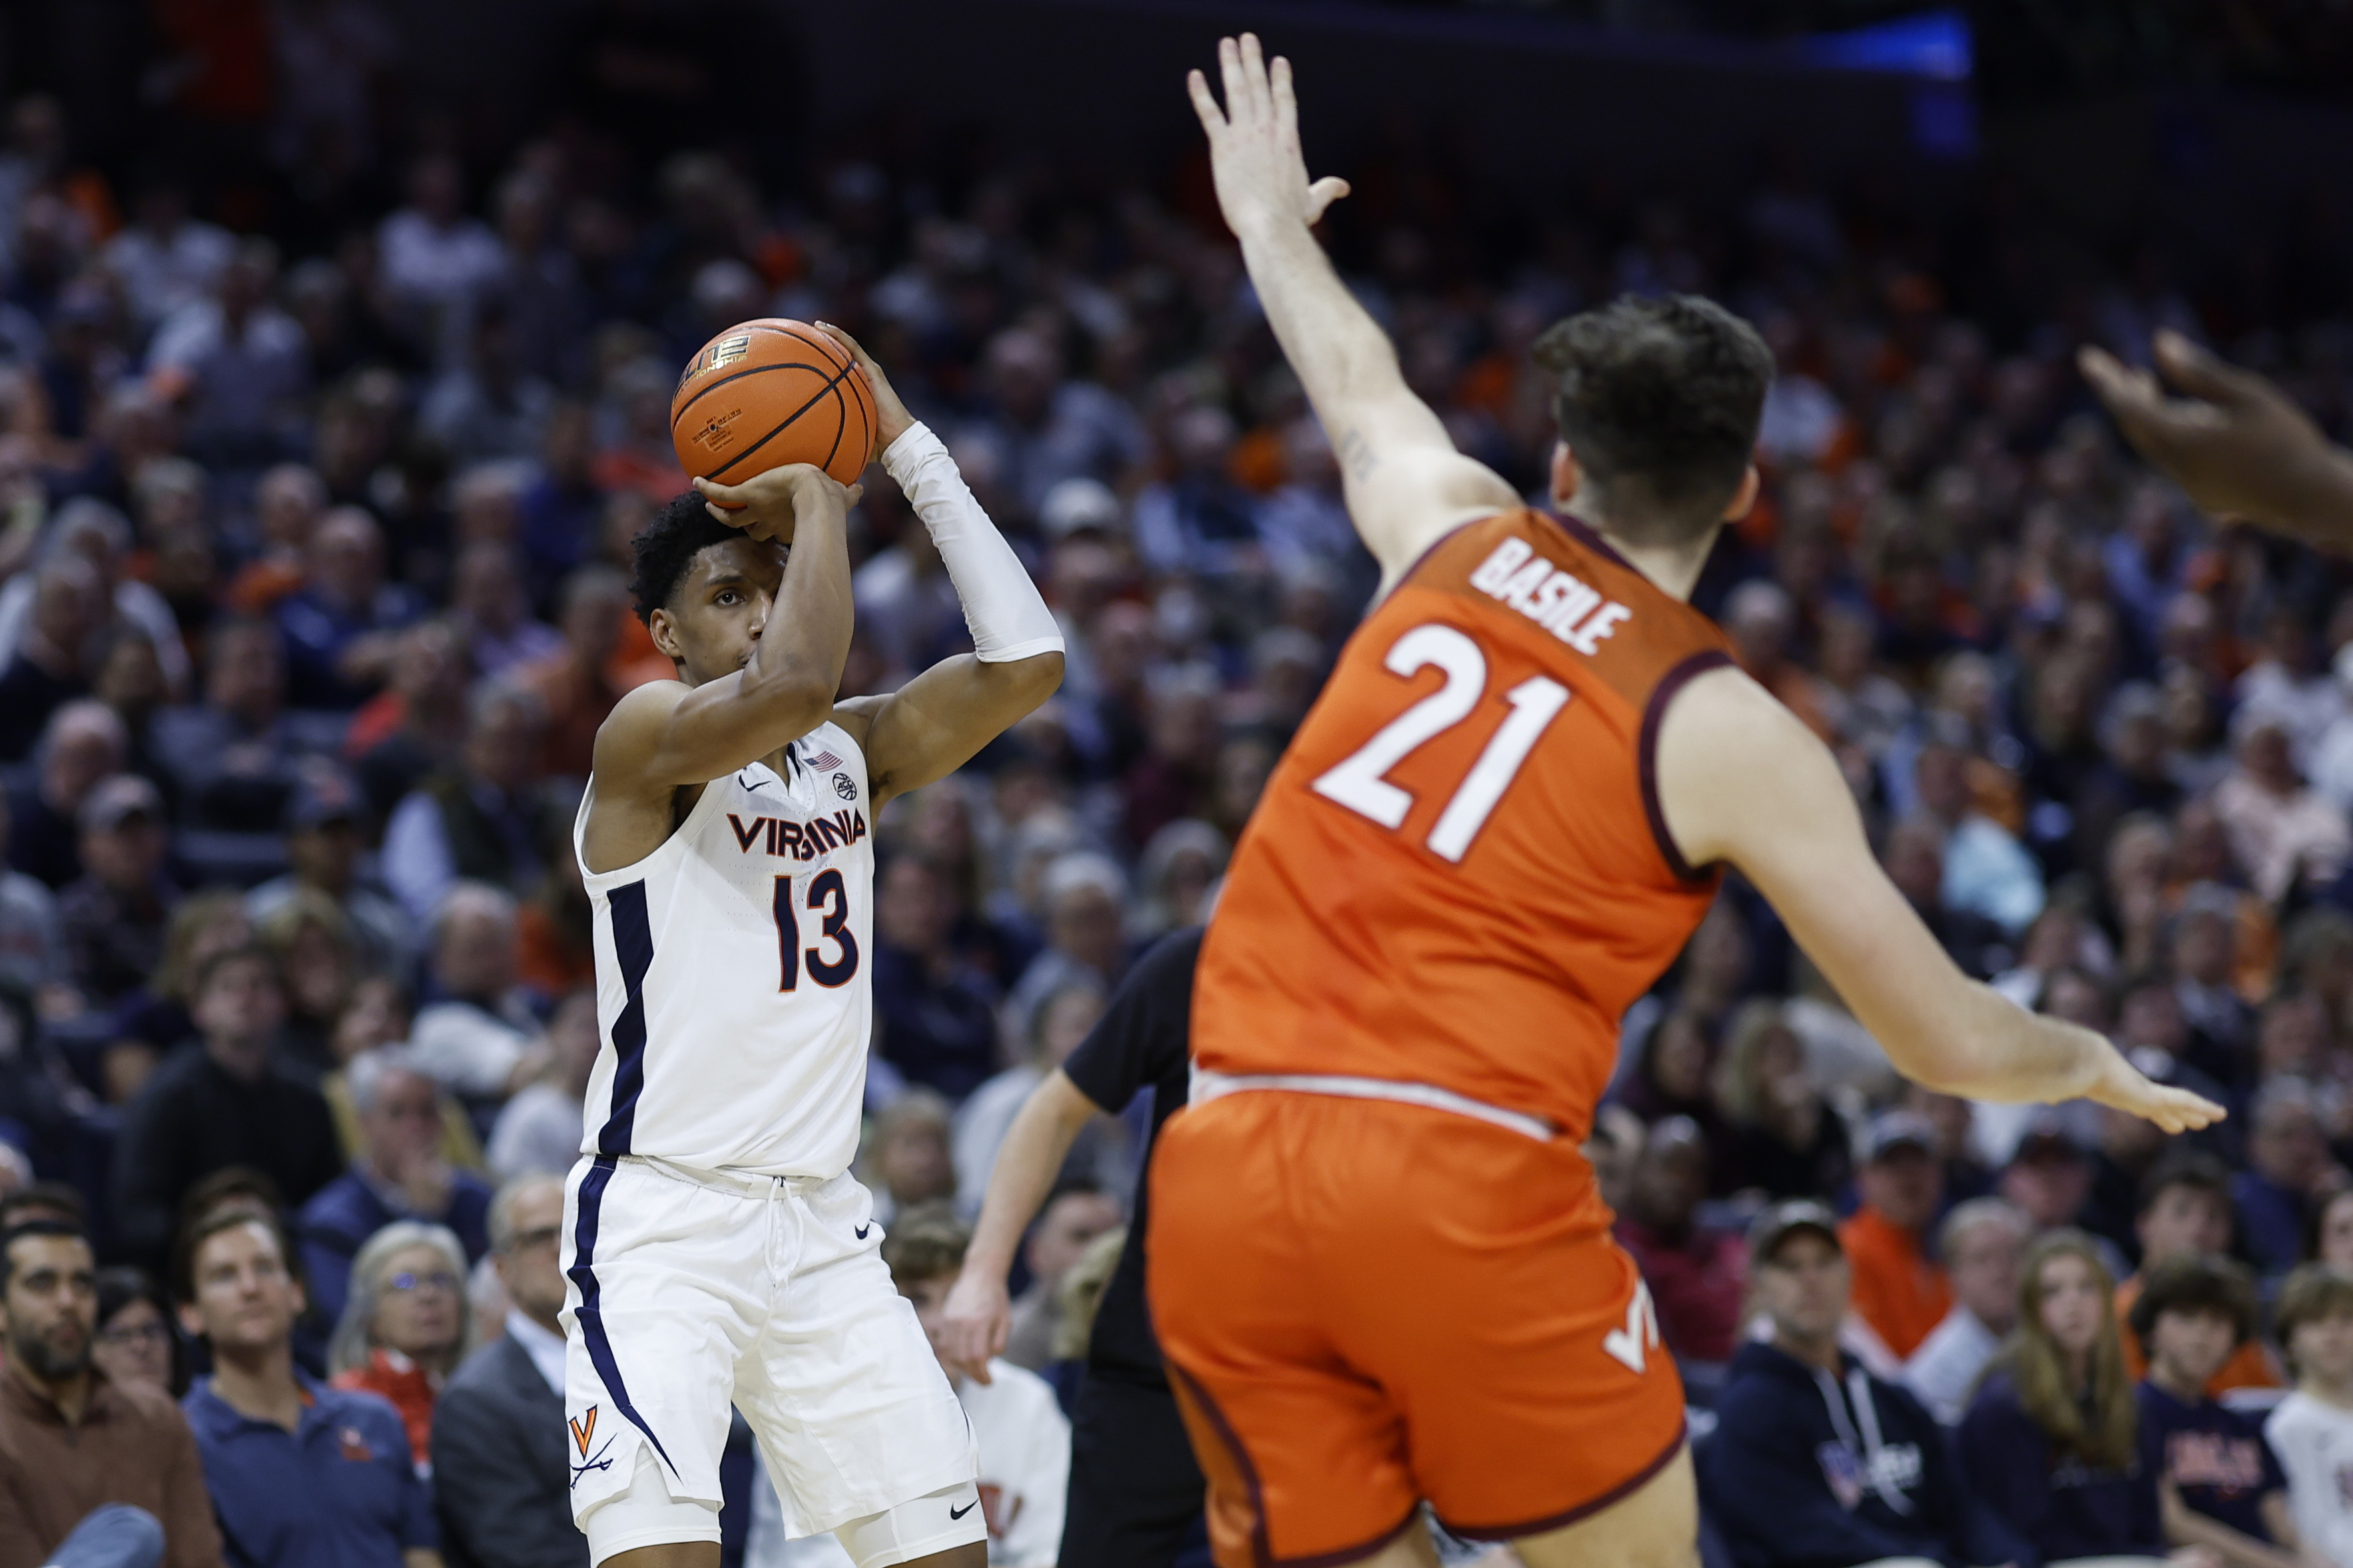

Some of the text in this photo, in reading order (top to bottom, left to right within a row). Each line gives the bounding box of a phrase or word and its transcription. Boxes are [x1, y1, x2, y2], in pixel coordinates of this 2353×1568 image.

[1469, 536, 1633, 656] BASILE
[837, 779, 853, 790] ACC
[1311, 623, 1570, 864] 21
[773, 868, 858, 992] 13
[568, 1403, 598, 1461] V
